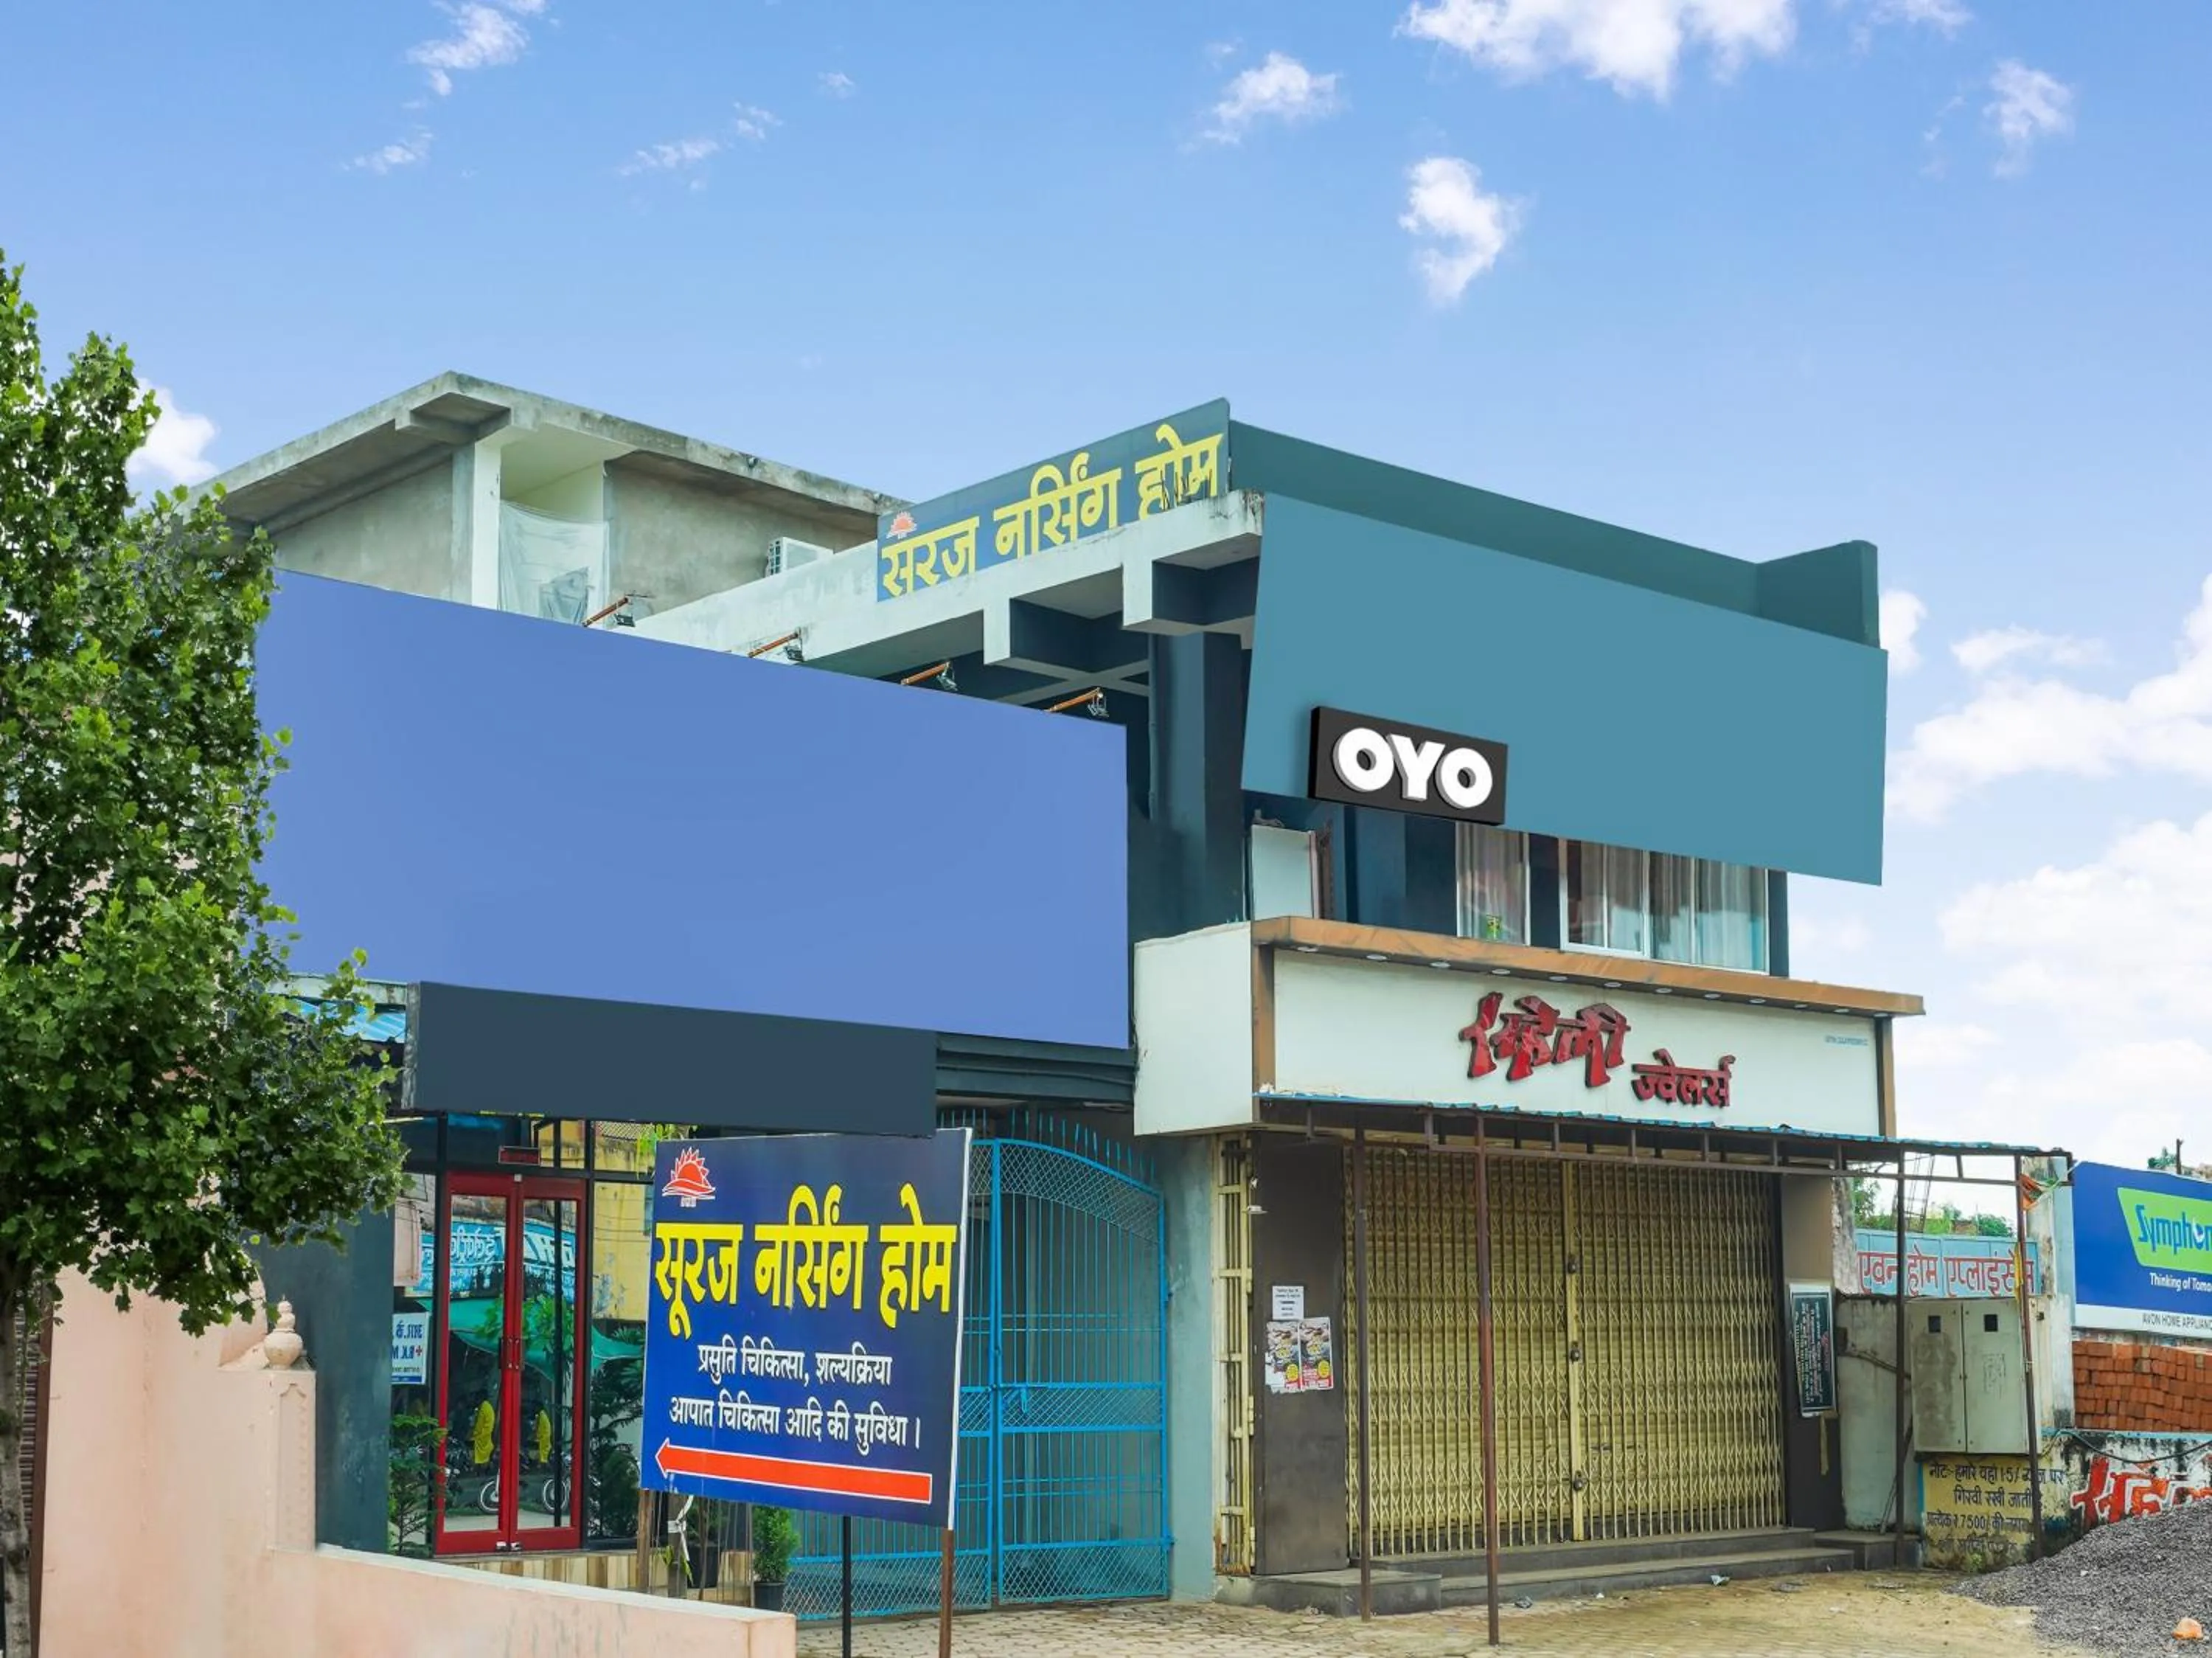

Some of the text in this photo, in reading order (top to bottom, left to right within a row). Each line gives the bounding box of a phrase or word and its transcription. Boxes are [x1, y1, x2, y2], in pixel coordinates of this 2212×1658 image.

[993, 452, 1121, 560] नर्सिंग
[1135, 423, 1224, 520] होम
[1332, 727, 1493, 809] OYO
[655, 1182, 958, 1339] सूरज नर्सिंग होम
[1907, 1244, 1938, 1297] होम
[2149, 1272, 2182, 1292] Thinking
[2183, 1277, 2191, 1290] of
[2143, 1314, 2161, 1326] AVON
[2162, 1315, 2181, 1328] HOME
[698, 1333, 893, 1387] प्रसुति चिकित्सा, शल्यक्रिया
[669, 1397, 714, 1427] आपात
[717, 1388, 780, 1435] चिकित्सा
[784, 1396, 824, 1442] आदि
[827, 1399, 850, 1441] की
[853, 1401, 908, 1456] सुविधा
